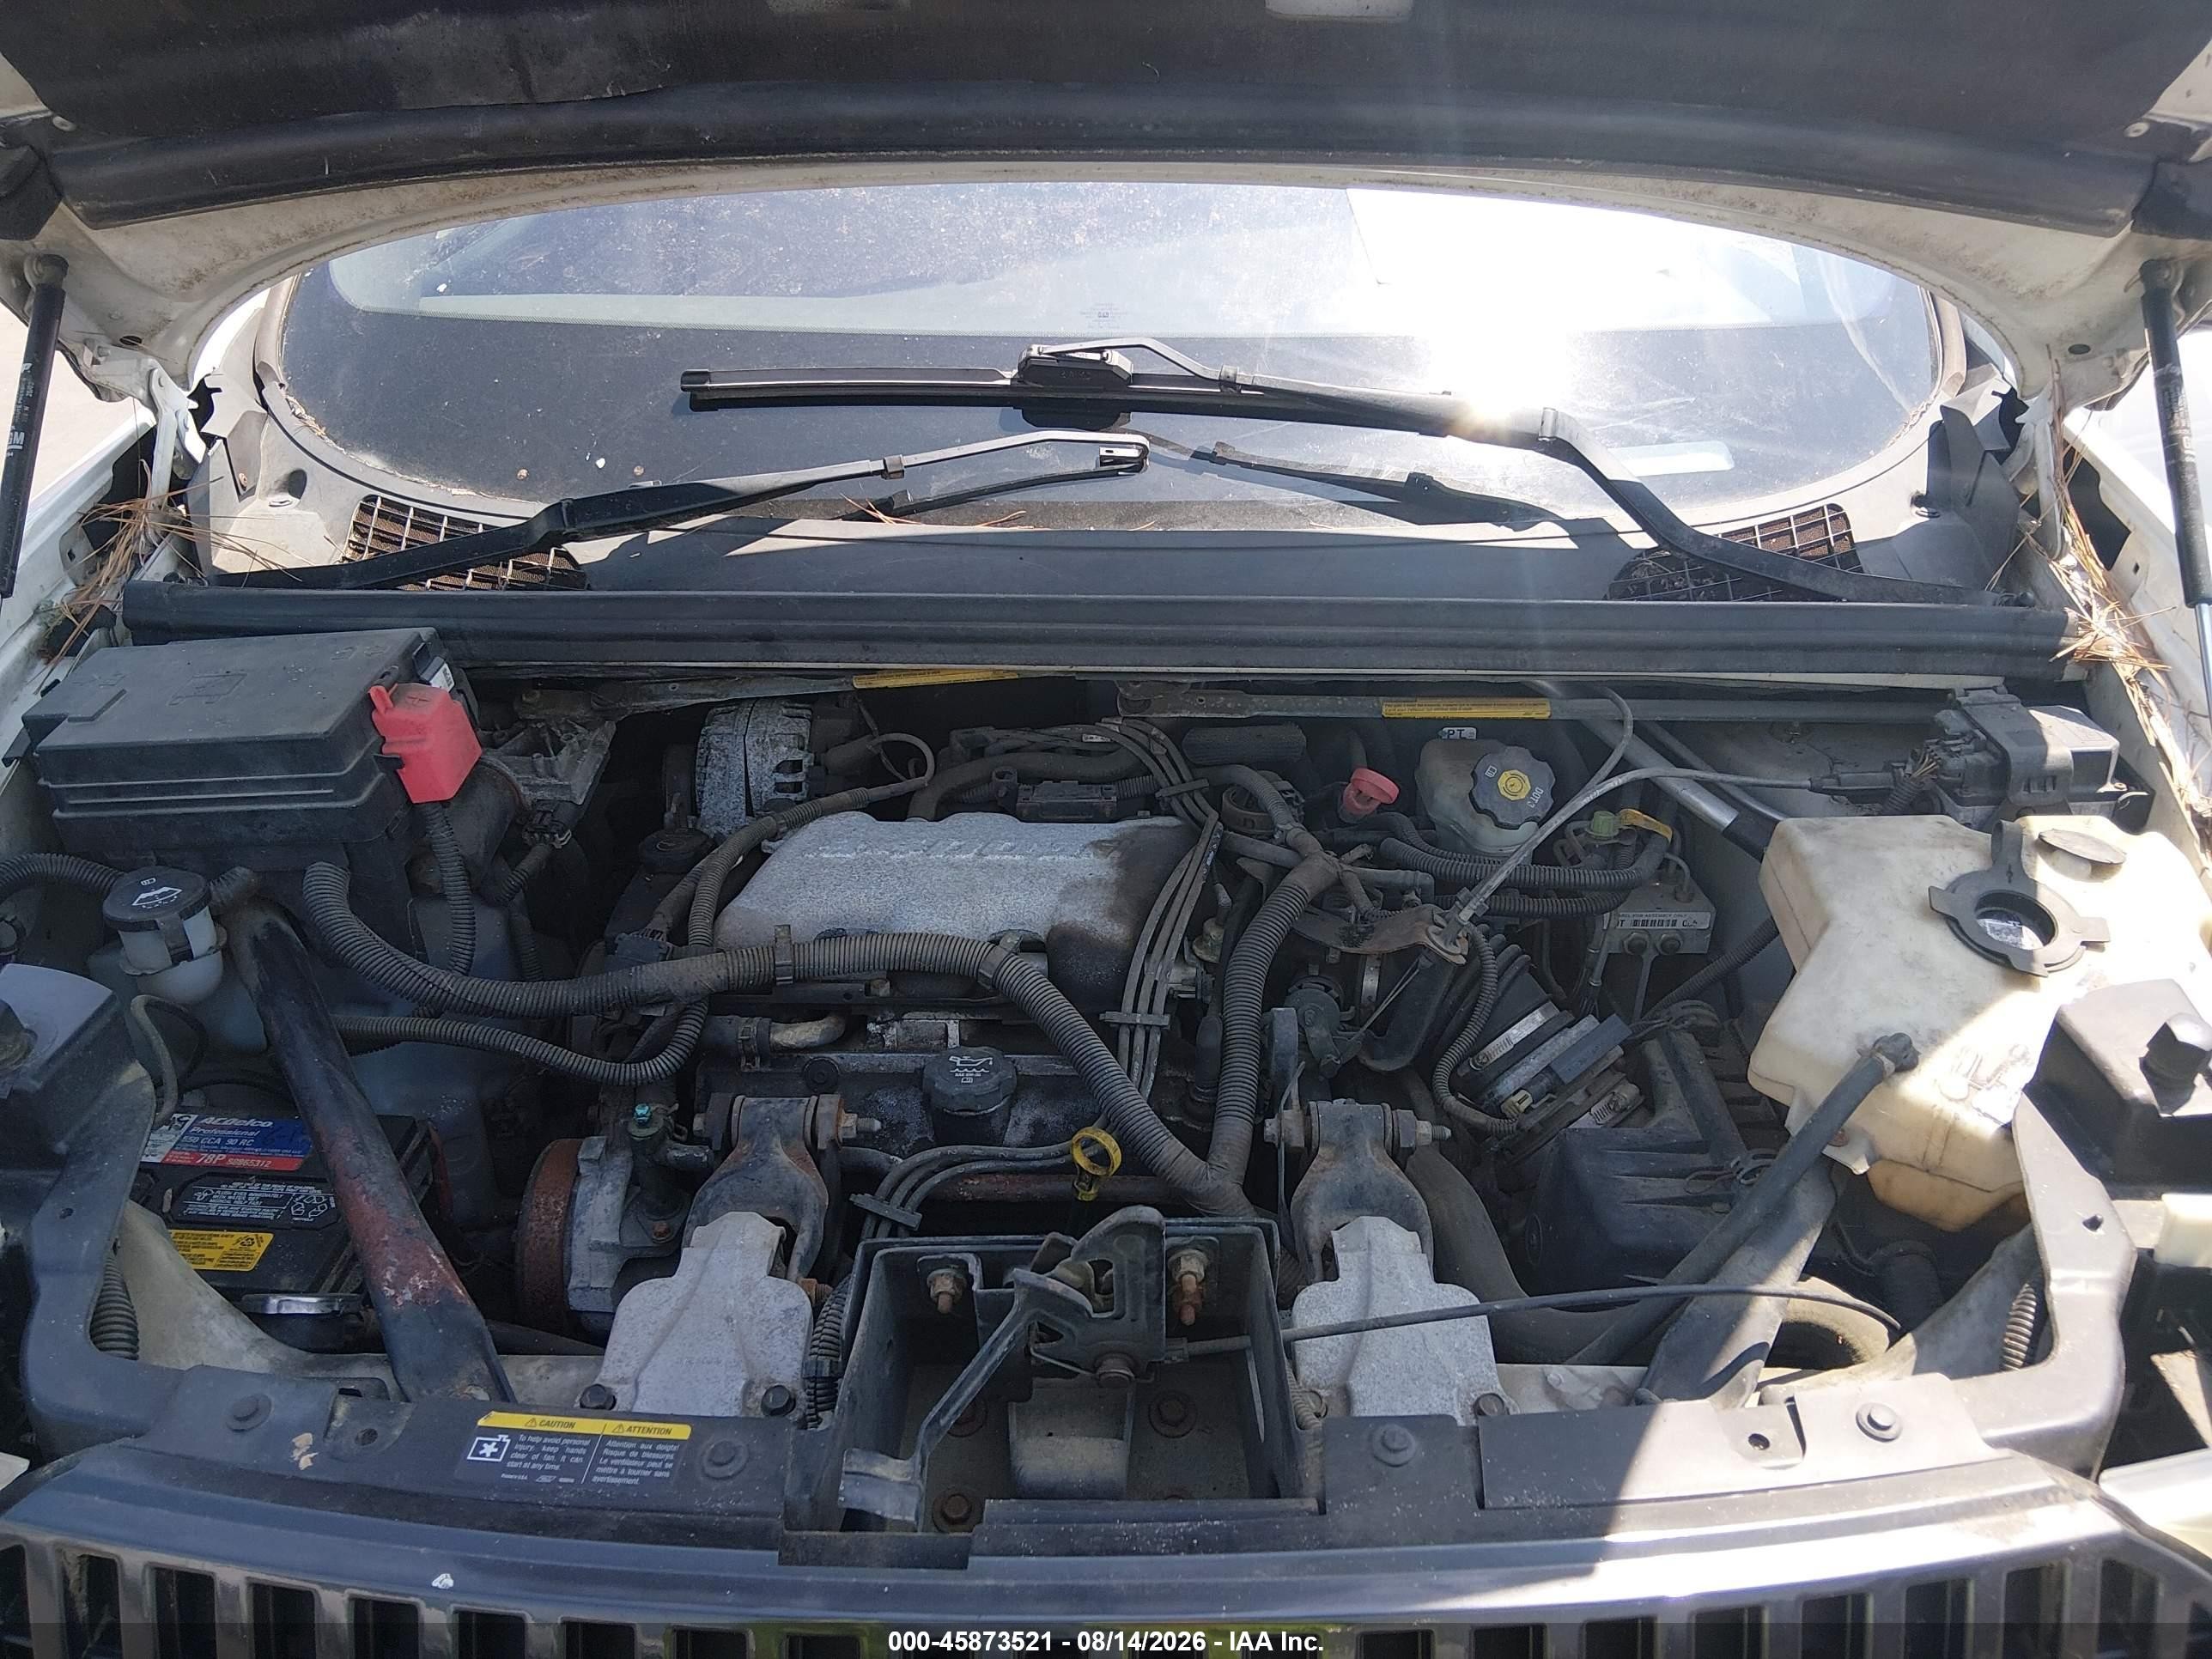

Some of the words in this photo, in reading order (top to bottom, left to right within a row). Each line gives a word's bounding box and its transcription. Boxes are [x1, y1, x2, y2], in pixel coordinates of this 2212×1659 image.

[198, 1116, 273, 1127] ACDelco
[189, 1126, 261, 1137] Professional
[200, 1136, 223, 1146] CCA
[225, 1138, 239, 1146] 90
[240, 1138, 255, 1147] RC
[196, 1153, 228, 1164] 78P
[538, 1419, 576, 1429] CAUTION
[626, 1425, 672, 1435] ATTENTION
[526, 1435, 542, 1443] help
[543, 1436, 562, 1444] avoid
[562, 1437, 591, 1446] personal
[605, 1439, 636, 1449] Attention
[542, 1443, 559, 1453] keep
[566, 1446, 587, 1455] hands
[603, 1449, 626, 1457] Risque
[610, 1458, 645, 1467] ventilateur
[647, 1461, 662, 1469] peut
[595, 1466, 617, 1474] mettre
